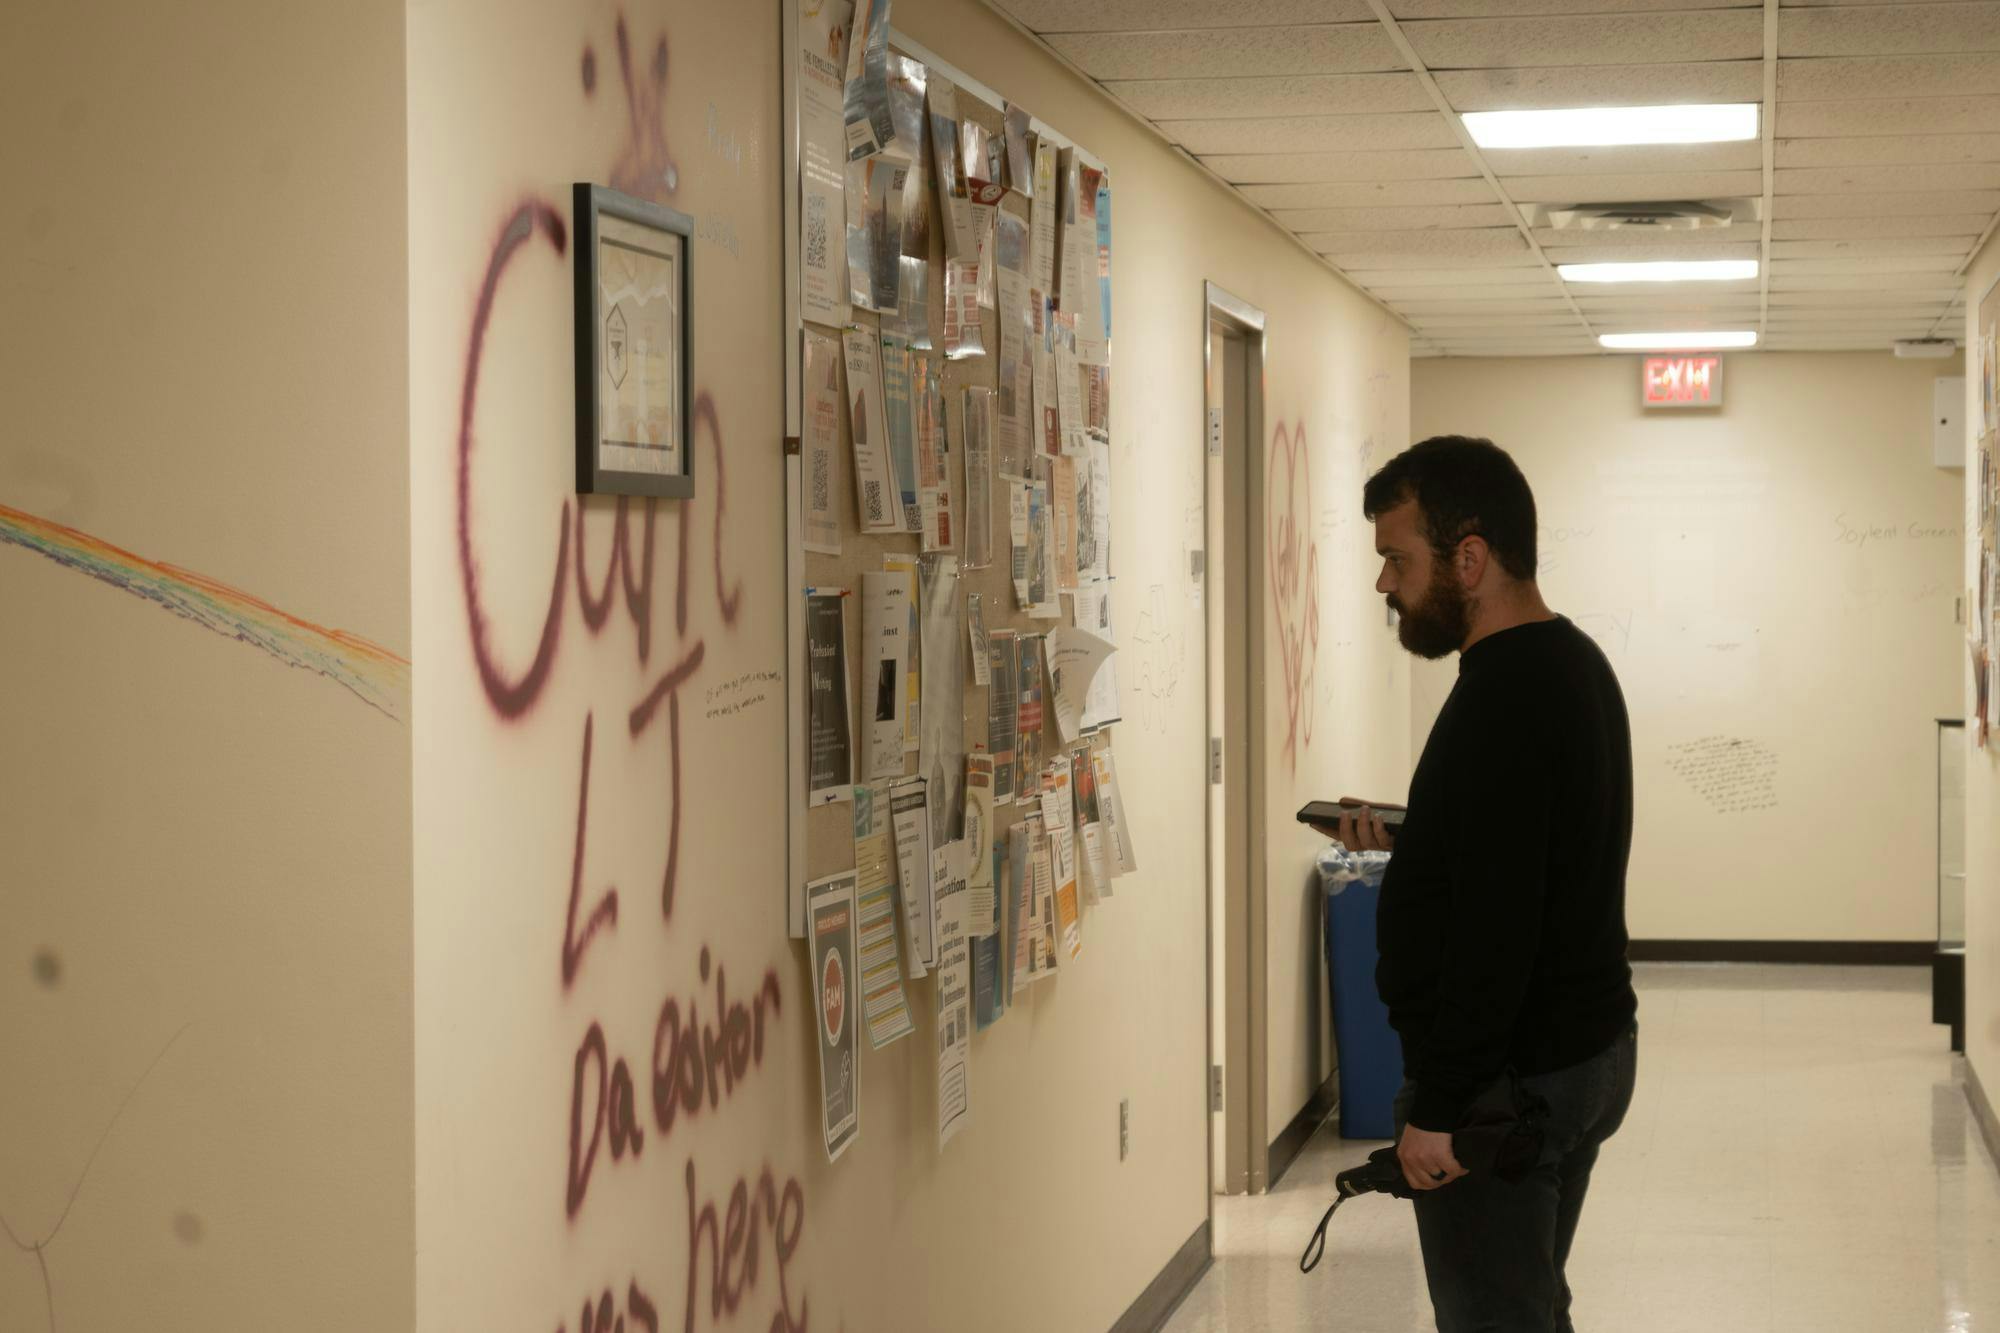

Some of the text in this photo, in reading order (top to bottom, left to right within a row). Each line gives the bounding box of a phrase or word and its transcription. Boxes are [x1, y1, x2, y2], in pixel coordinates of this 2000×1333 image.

[1647, 357, 1717, 401] EXIT
[1833, 512, 1958, 548] Soylent Green
[826, 984, 841, 1010] FAM
[653, 944, 783, 1137] editor
